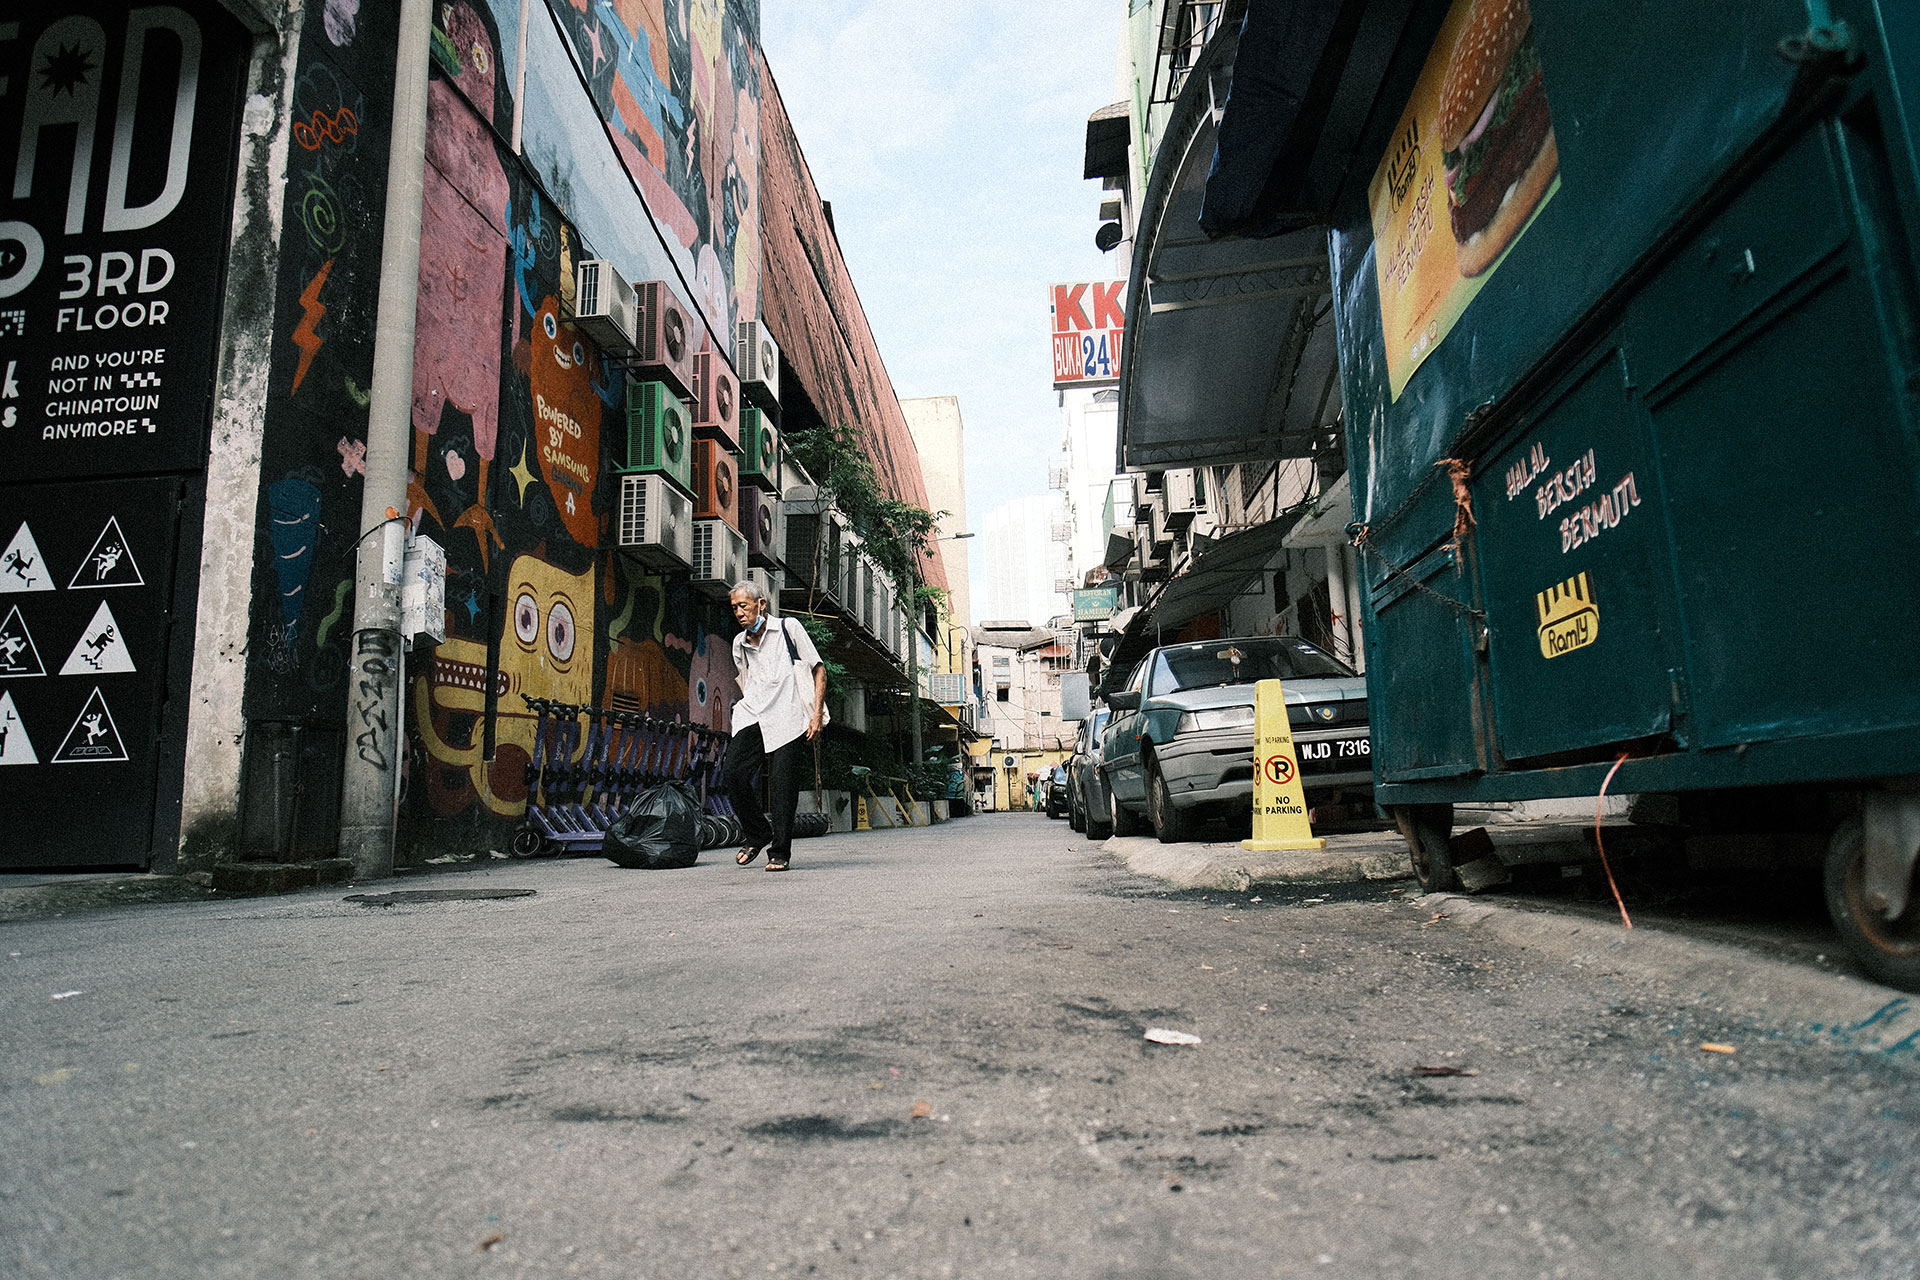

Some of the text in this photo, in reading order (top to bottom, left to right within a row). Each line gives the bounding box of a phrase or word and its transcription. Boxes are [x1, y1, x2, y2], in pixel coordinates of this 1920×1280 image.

[1397, 155, 1416, 206] Ramly
[1408, 165, 1435, 240] BERSIH
[59, 248, 175, 300] 3RD
[56, 300, 169, 333] FLOOR
[1055, 280, 1127, 332] KK
[51, 349, 166, 371] AND YOU'RE
[1054, 335, 1083, 377] BUKA
[1083, 334, 1111, 377] 24
[48, 375, 113, 394] NOT IN
[45, 394, 160, 417] CHINATOWN
[536, 394, 582, 439] POWERED
[42, 419, 138, 440] ANYMORE
[549, 426, 563, 448] BY
[543, 445, 592, 483] SAMSUNG
[1506, 441, 1550, 501] HALAL
[1535, 448, 1596, 520] BERSIH
[565, 491, 576, 516] A
[1548, 615, 1588, 656] Ramly
[1265, 736, 1272, 744] NO
[1272, 736, 1289, 744] PARKING
[1302, 739, 1371, 760] WJD 7316
[1265, 806, 1303, 815] PARKING
[1275, 796, 1290, 805] NO
